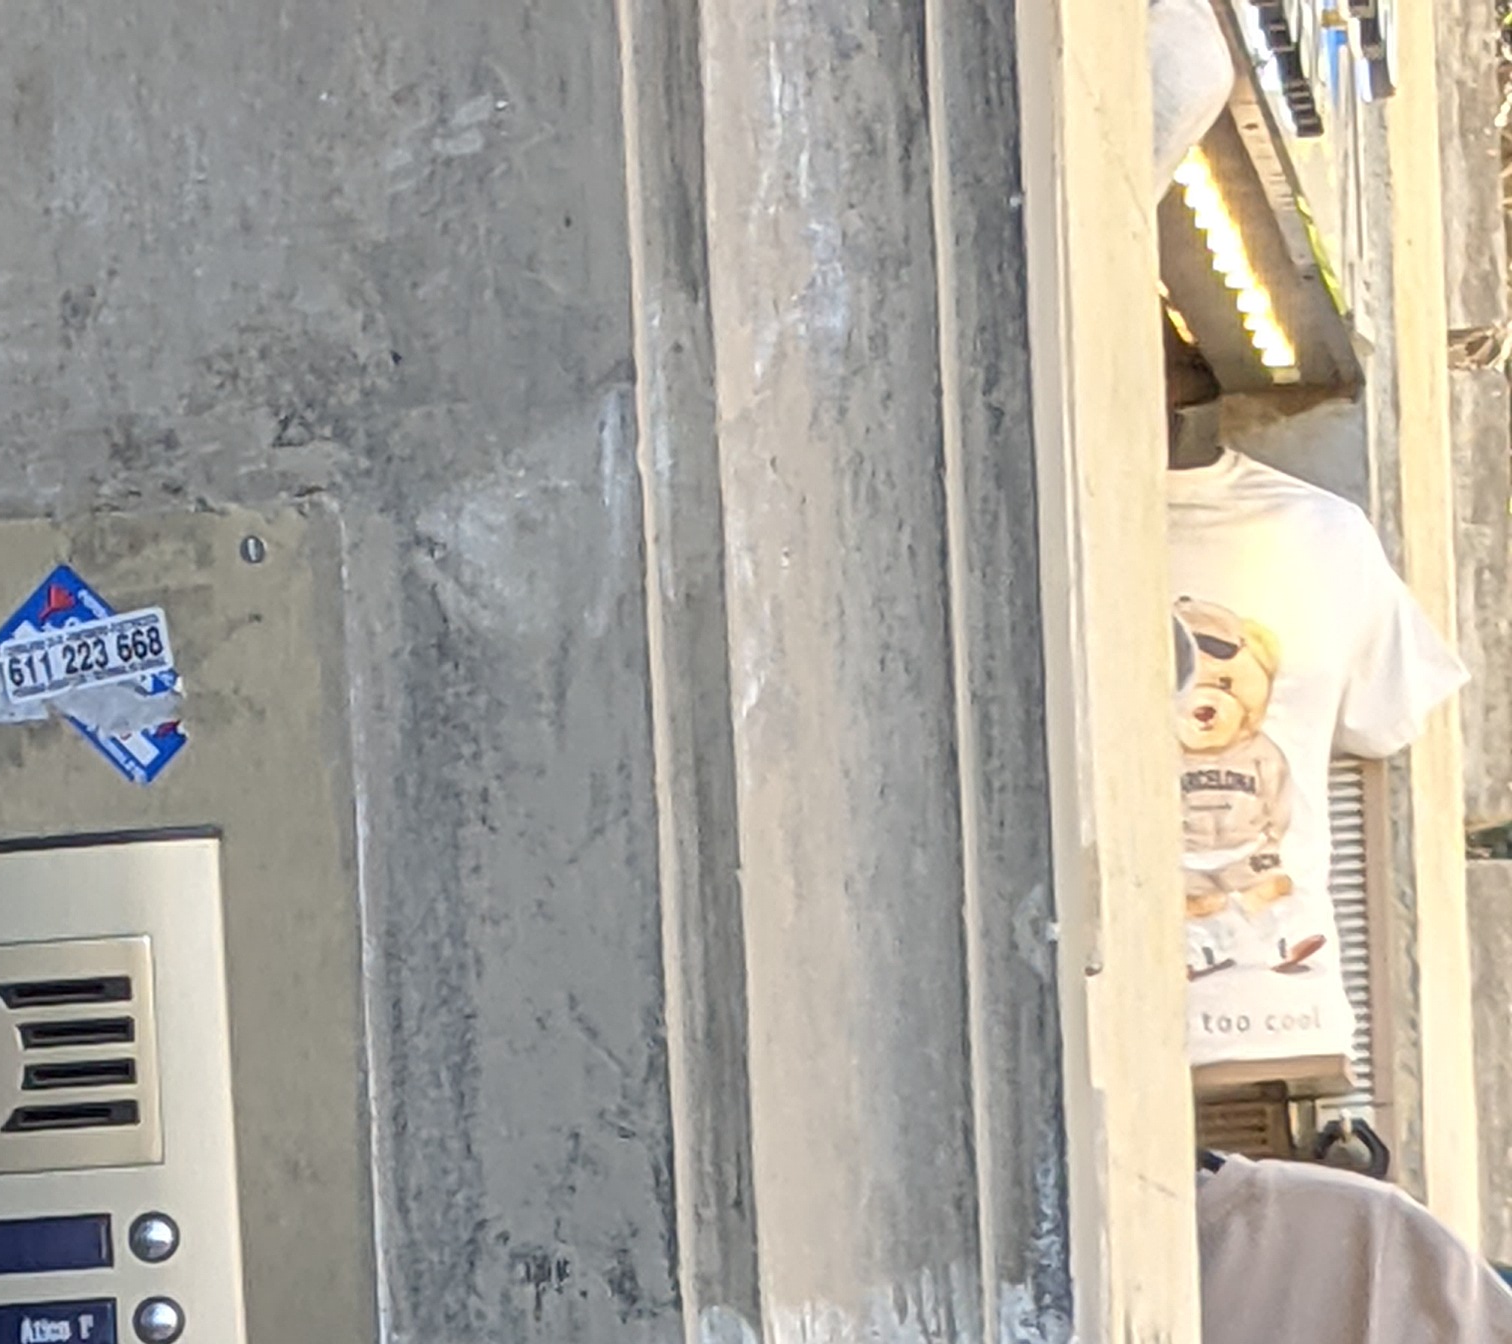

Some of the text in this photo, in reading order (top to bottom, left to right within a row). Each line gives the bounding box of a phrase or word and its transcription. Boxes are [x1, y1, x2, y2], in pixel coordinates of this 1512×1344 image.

[8, 651, 54, 686] 611
[62, 638, 108, 675] 223
[116, 625, 164, 662] 668
[1202, 1005, 1321, 1034] too cool
